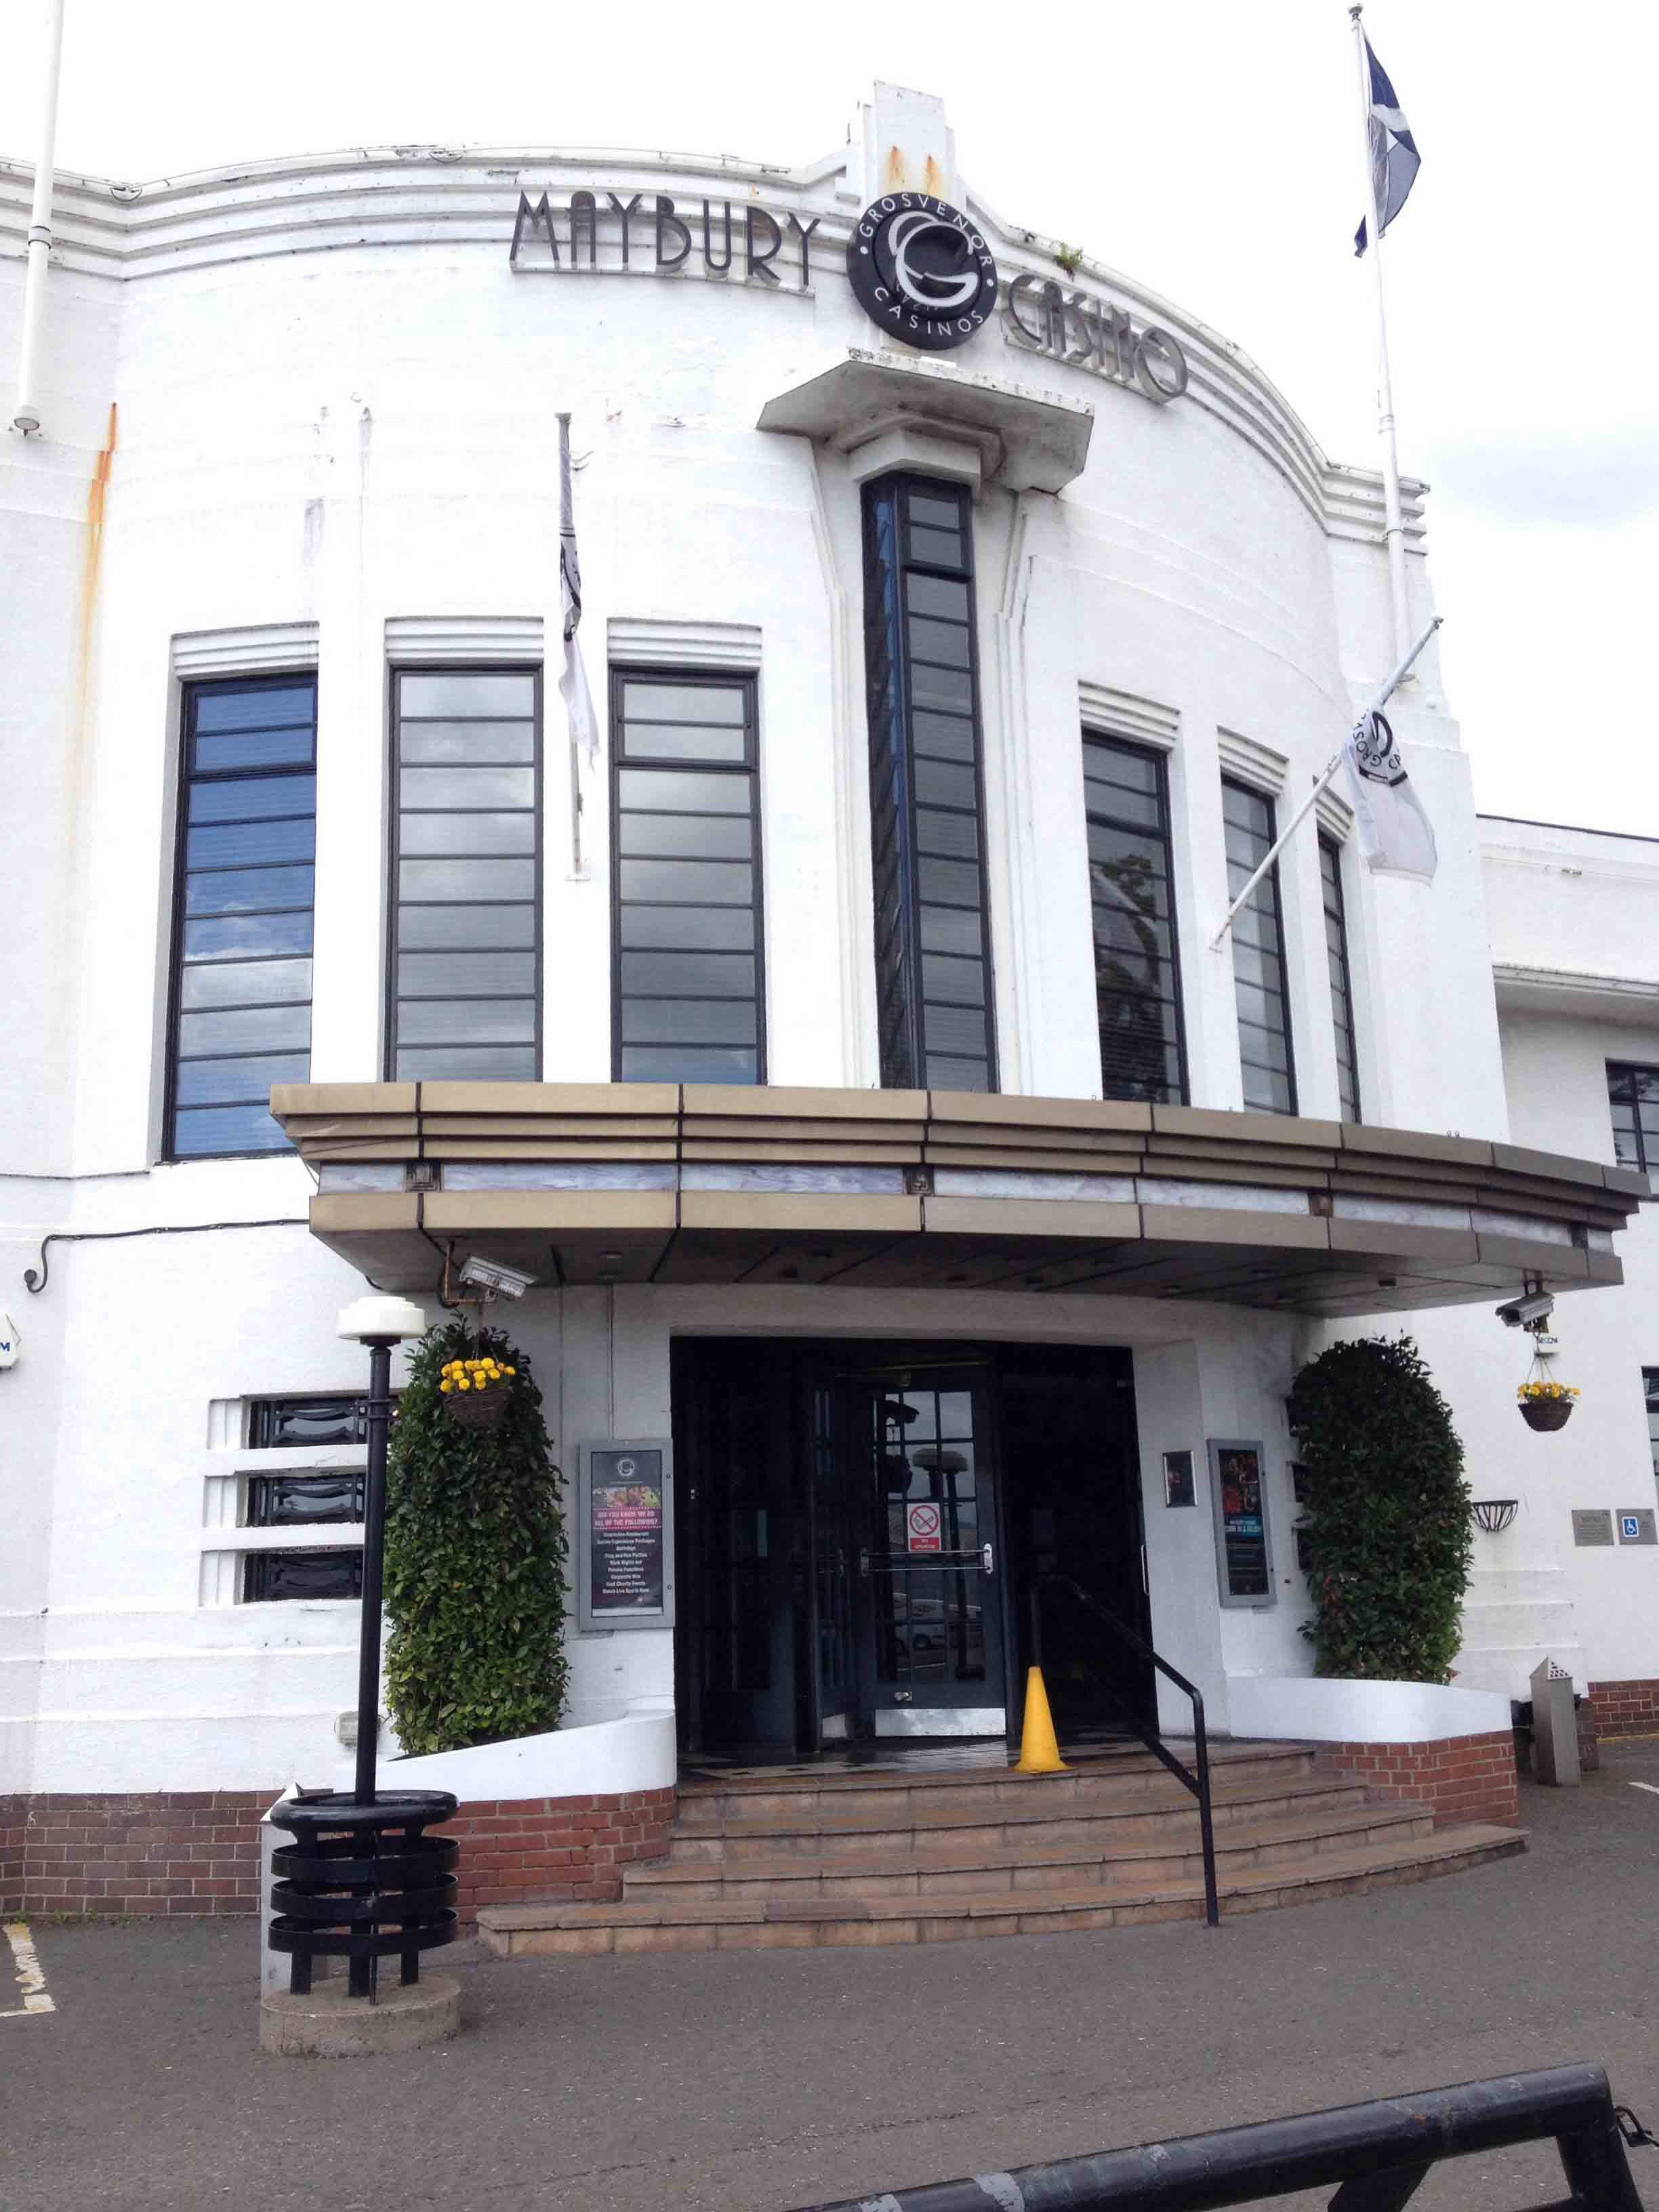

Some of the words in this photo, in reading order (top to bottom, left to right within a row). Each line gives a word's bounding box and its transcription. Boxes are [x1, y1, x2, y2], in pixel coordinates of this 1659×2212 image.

[510, 190, 821, 290] MAYBURY
[859, 193, 993, 266] GROSVENOR
[874, 287, 983, 336] CASINOS
[1008, 274, 1188, 400] CASINO
